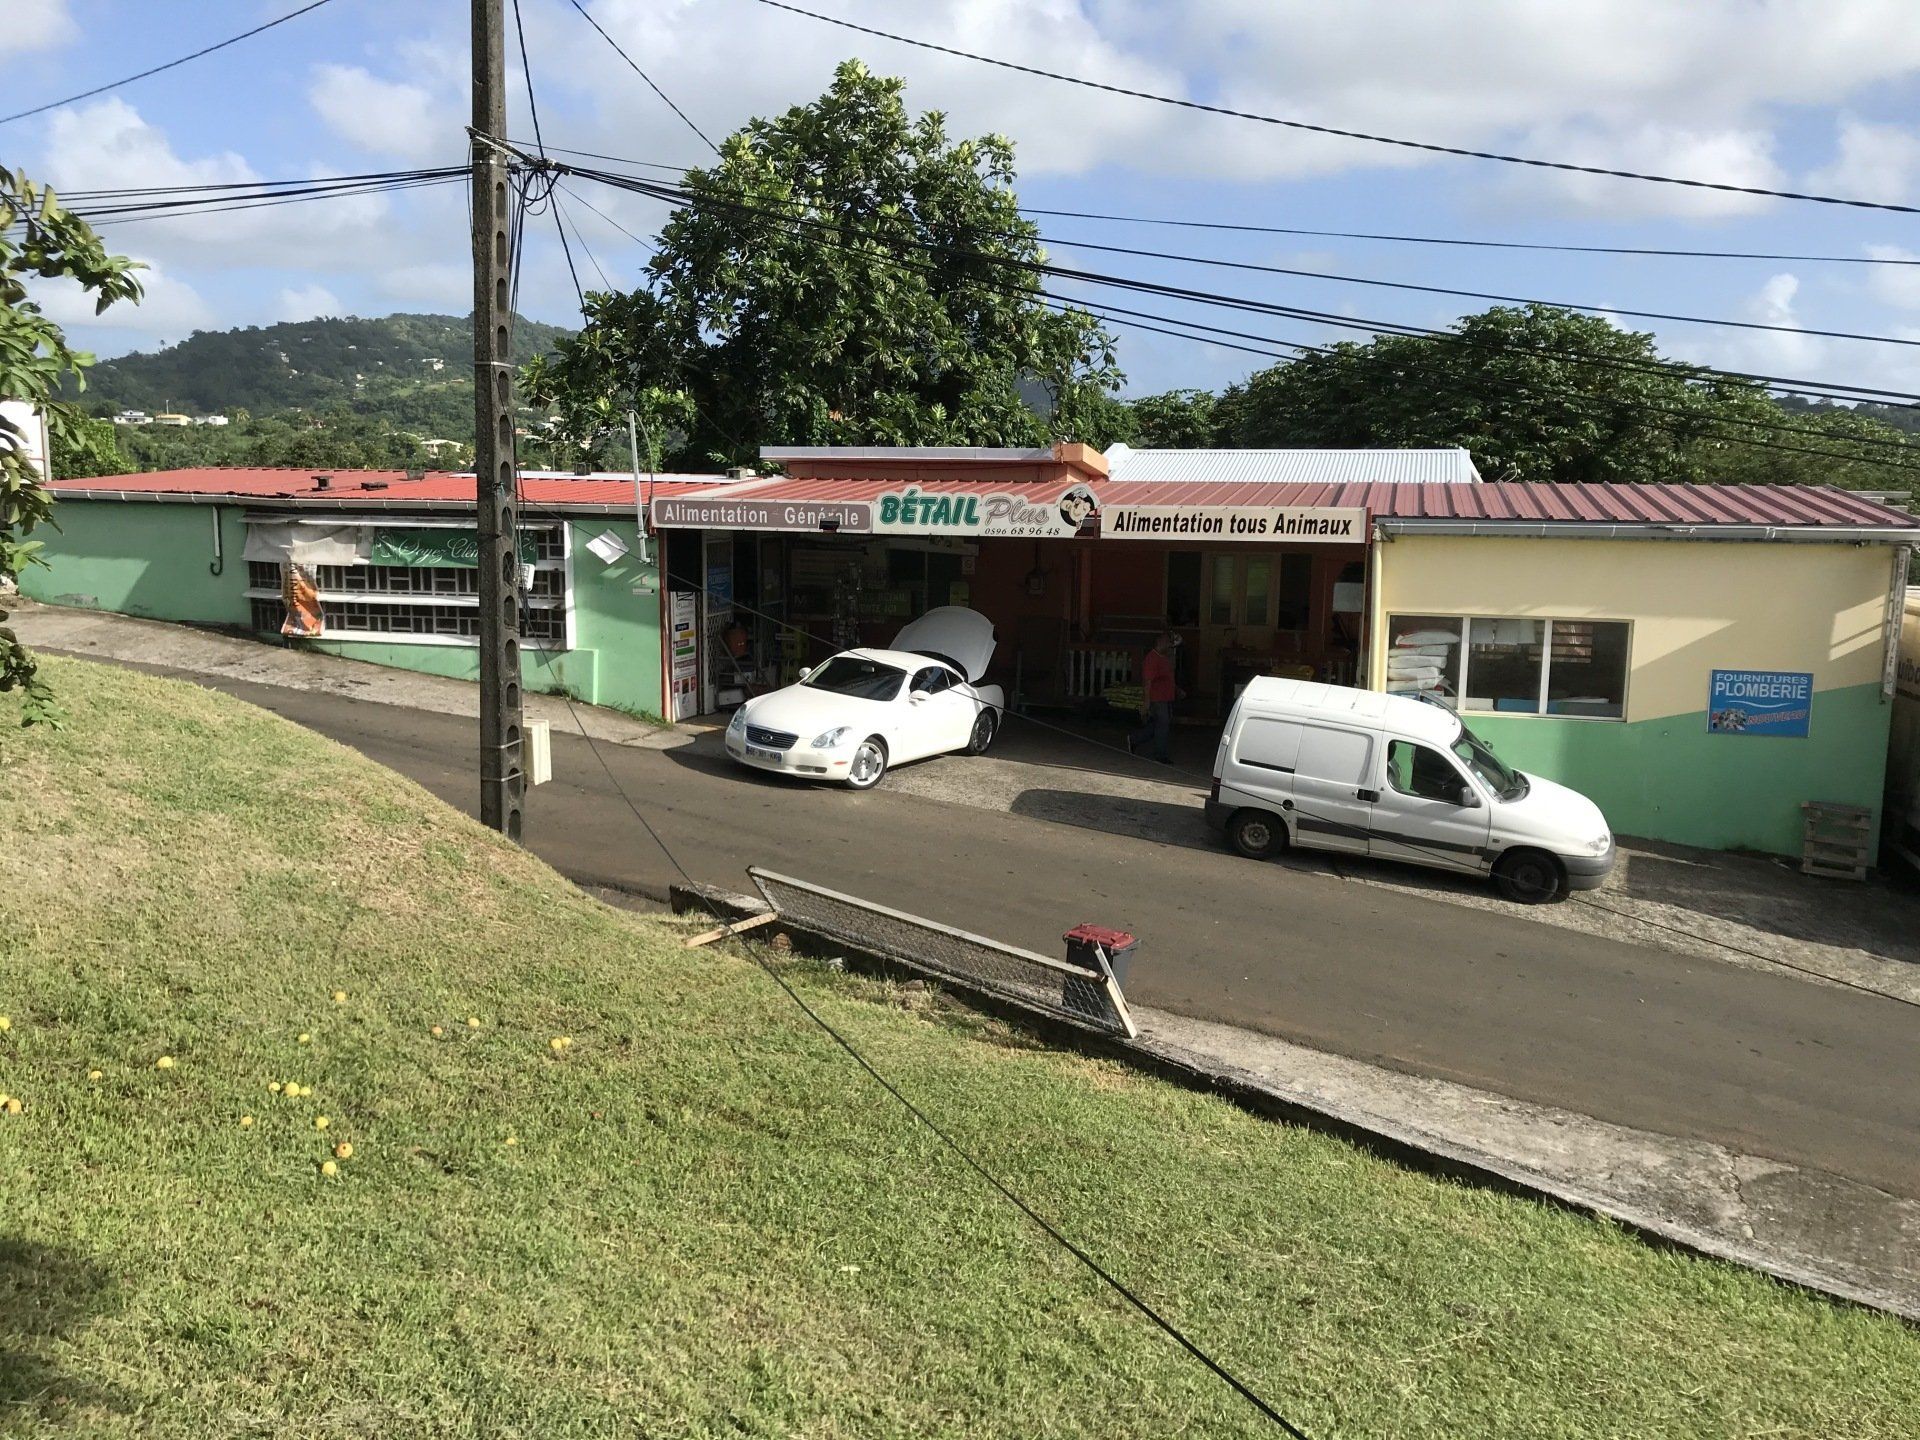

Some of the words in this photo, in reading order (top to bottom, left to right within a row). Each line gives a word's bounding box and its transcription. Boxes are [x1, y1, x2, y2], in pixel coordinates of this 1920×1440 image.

[664, 504, 768, 524] Alimentation
[880, 488, 980, 526] BÉTAIL
[985, 496, 1050, 526] Plus
[984, 527, 1007, 535] 0596
[1010, 526, 1025, 536] 68
[1028, 526, 1042, 536] 96
[1046, 527, 1061, 536] 48
[1113, 510, 1223, 533] Alimentation
[1229, 513, 1267, 534] tous
[1272, 513, 1353, 535] Animaux
[1716, 673, 1808, 685] FOURNITURES
[1715, 682, 1808, 699] PLOMBERIE
